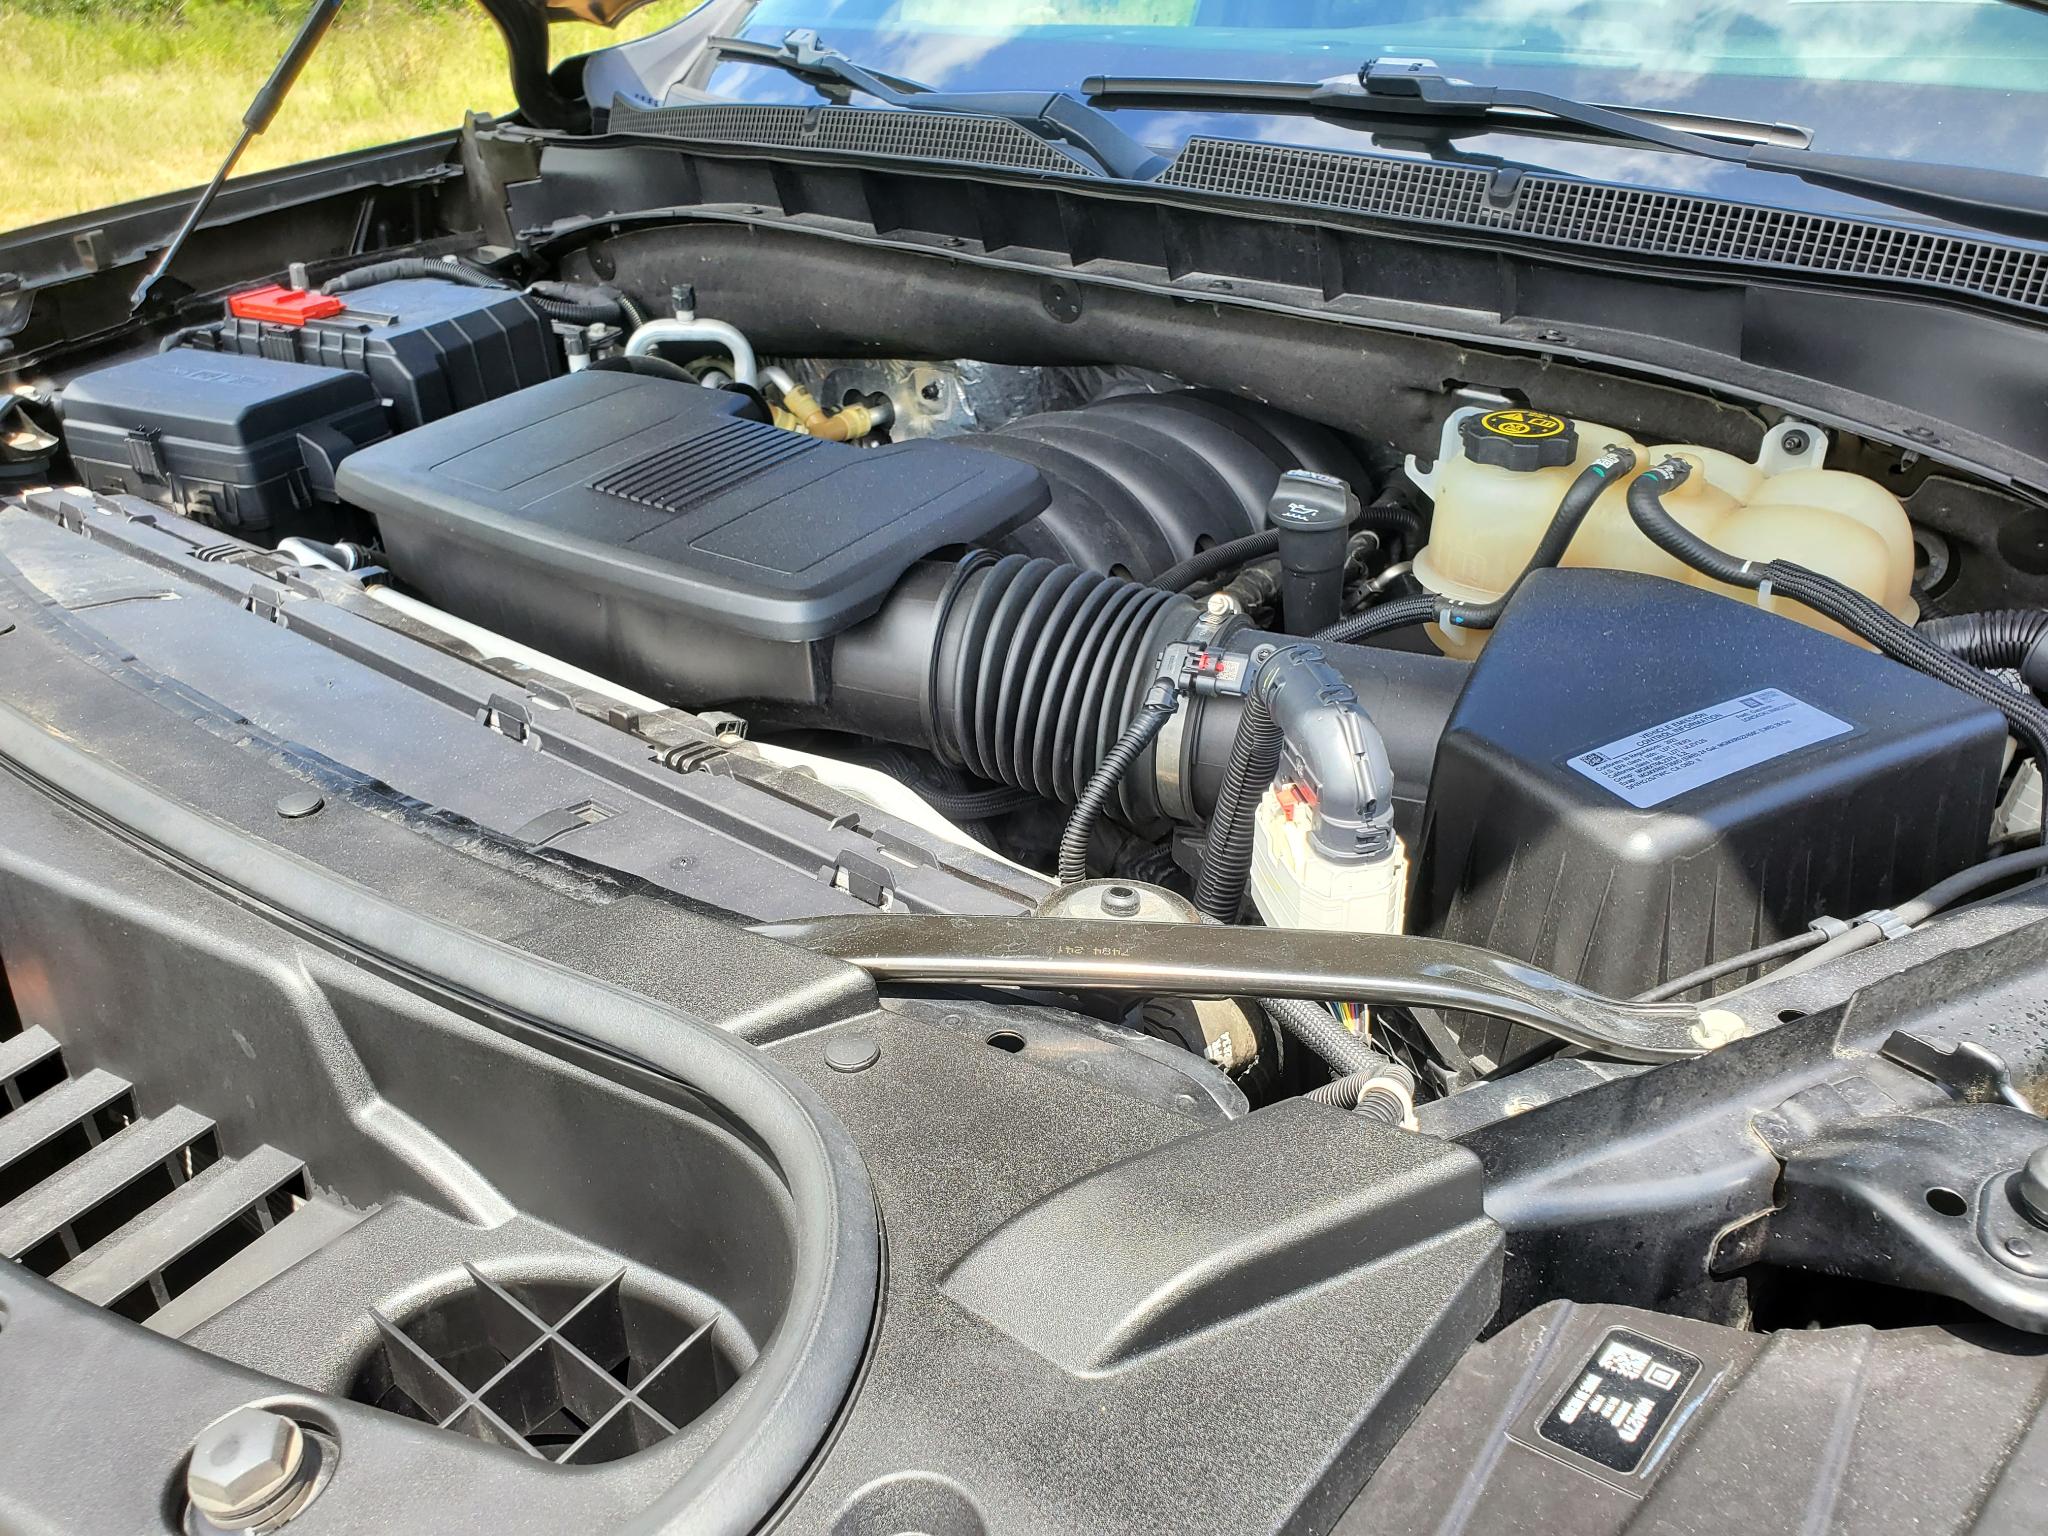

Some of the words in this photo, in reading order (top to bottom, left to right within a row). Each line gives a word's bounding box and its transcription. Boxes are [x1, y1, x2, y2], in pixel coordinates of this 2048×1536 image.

[1636, 731, 1672, 747] CONTROL
[1671, 712, 1723, 733] INFORMATION
[1639, 724, 1672, 739] VEHICLE
[1671, 712, 1708, 728] EMISSION
